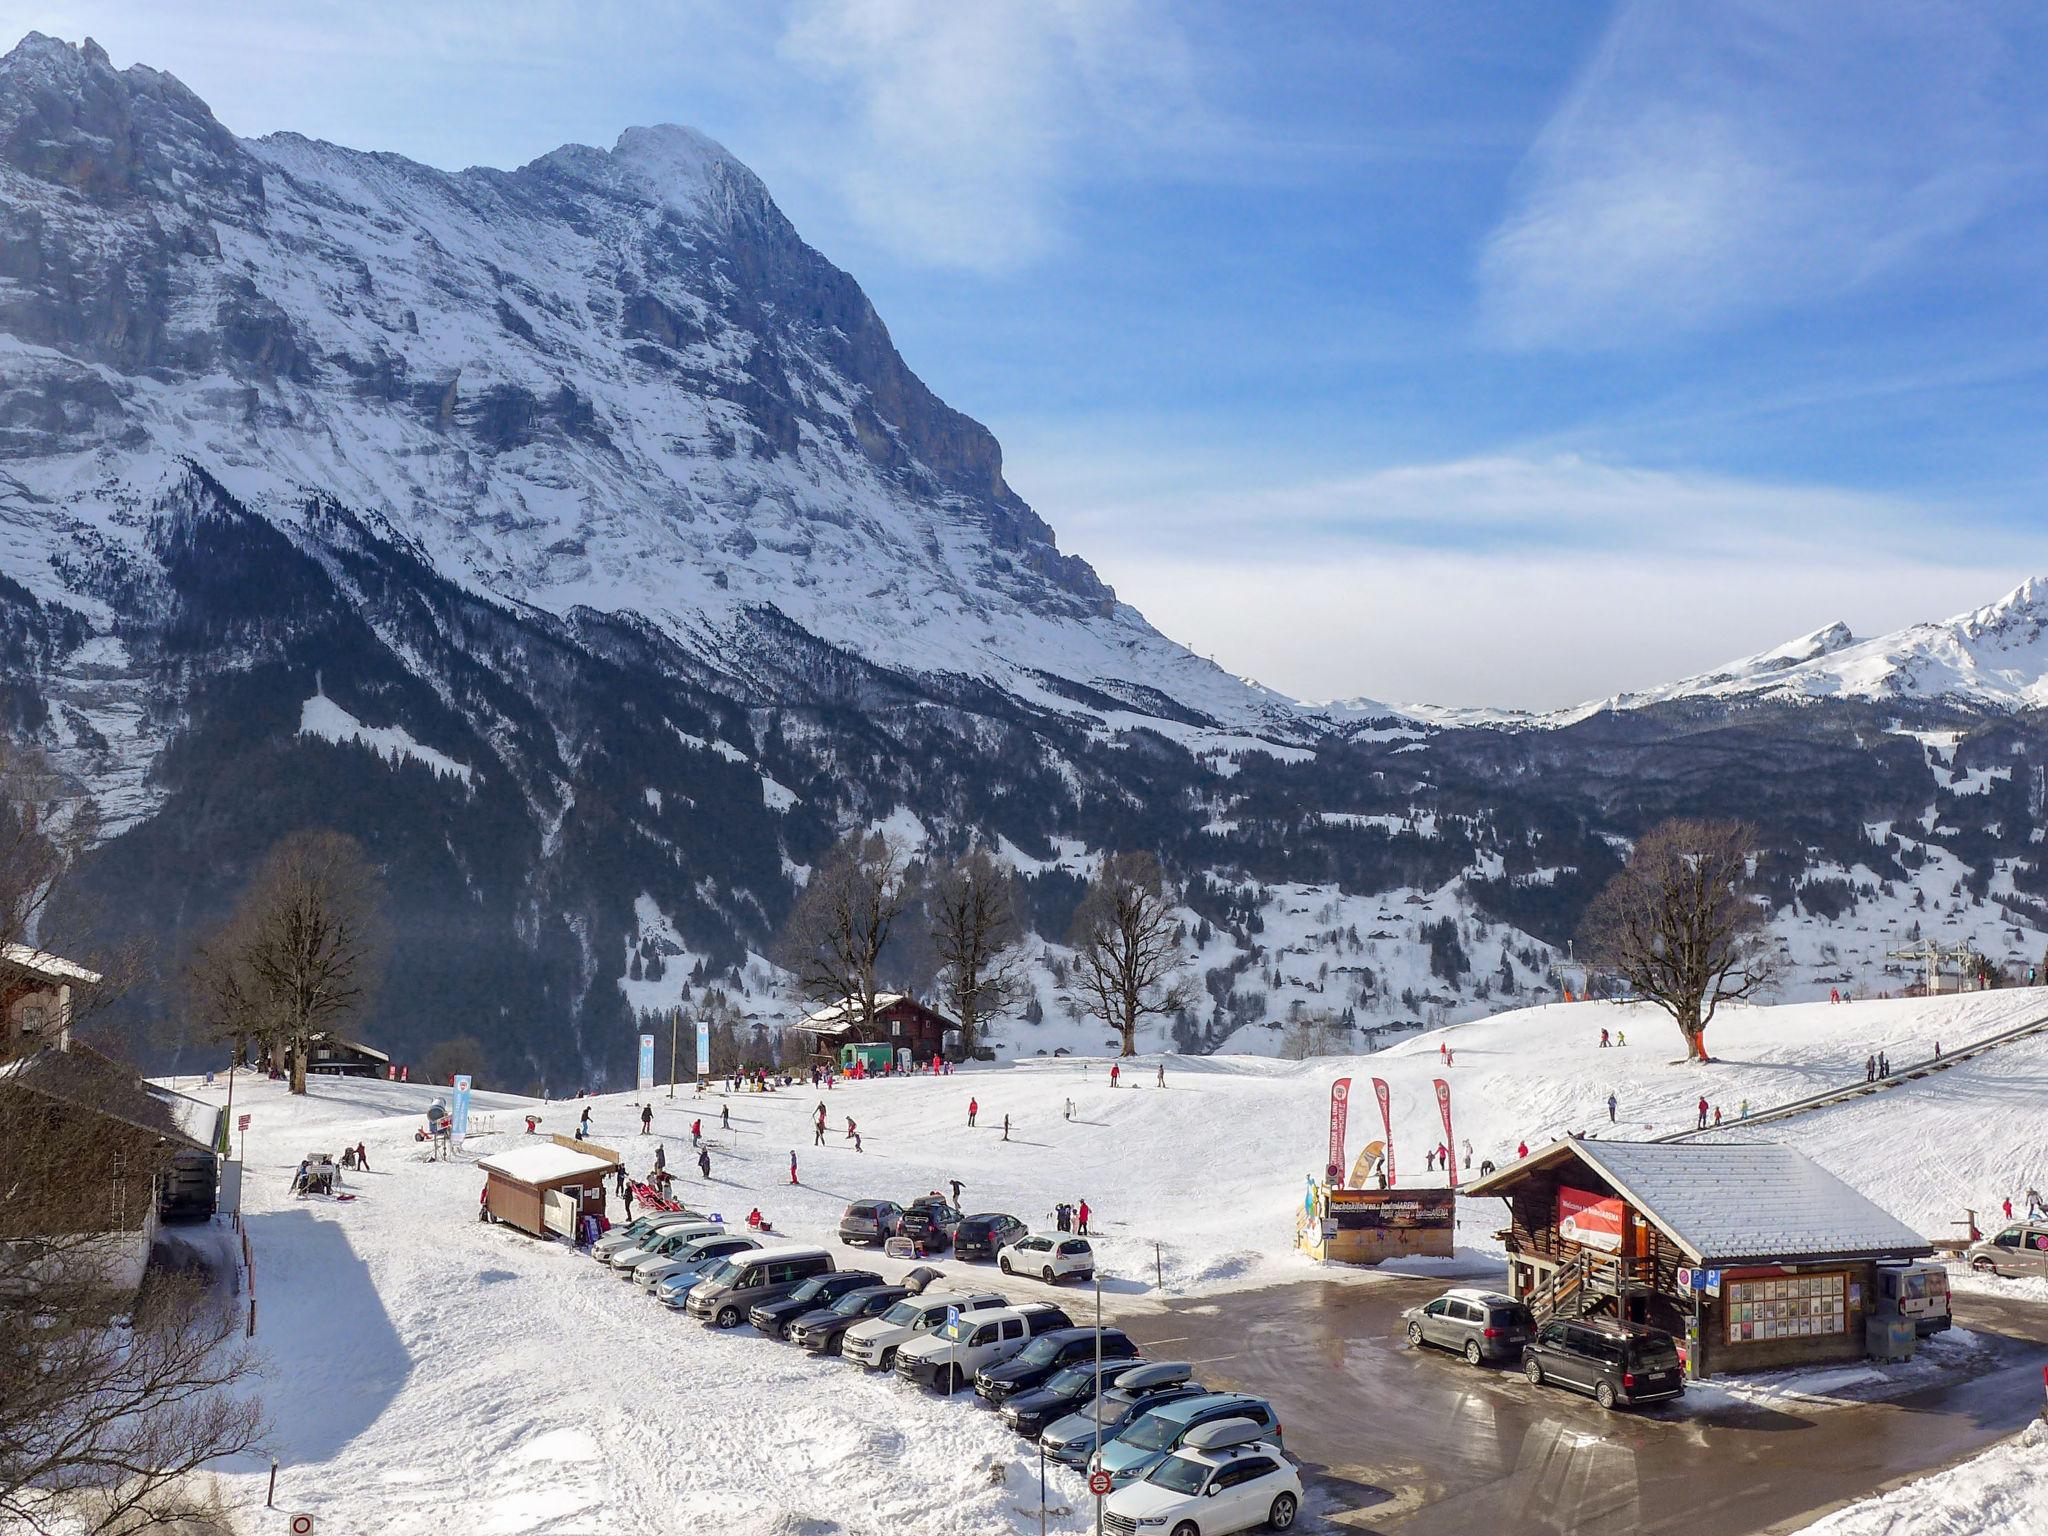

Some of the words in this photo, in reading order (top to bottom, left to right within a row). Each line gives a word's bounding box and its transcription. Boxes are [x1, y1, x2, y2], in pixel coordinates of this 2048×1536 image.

[1693, 1270, 1700, 1279] P
[1708, 1269, 1715, 1282] P
[949, 1309, 955, 1325] P
